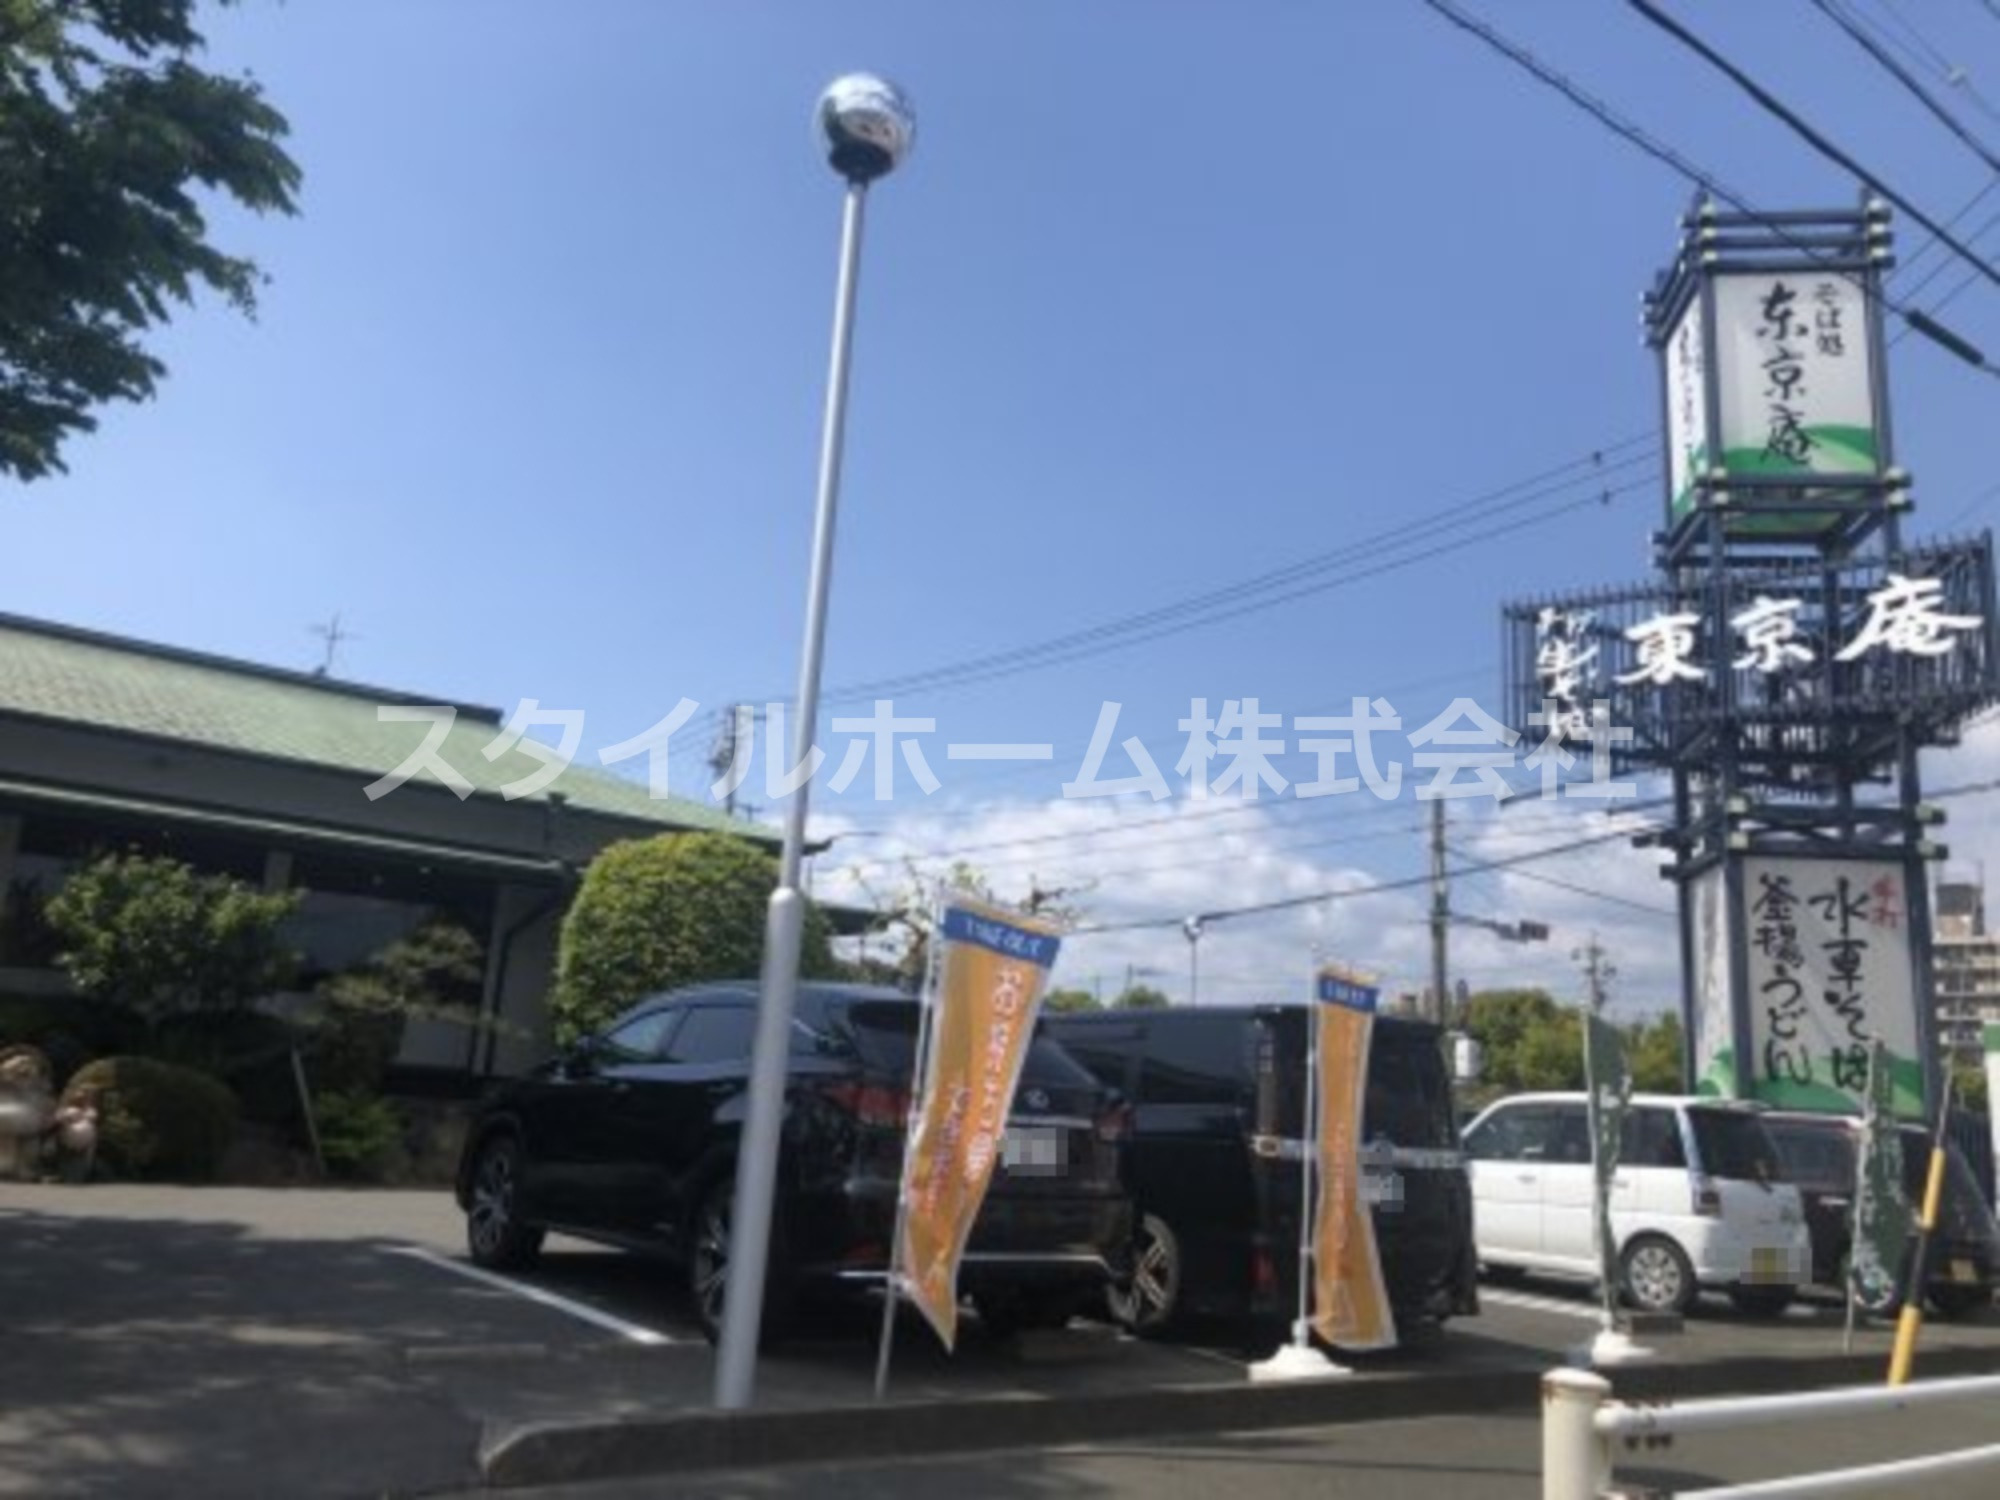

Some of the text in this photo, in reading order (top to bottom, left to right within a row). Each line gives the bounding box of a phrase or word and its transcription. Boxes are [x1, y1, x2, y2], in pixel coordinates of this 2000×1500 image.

[1613, 575, 1984, 686] 東京庵
[1808, 876, 1872, 1094] 水車そば
